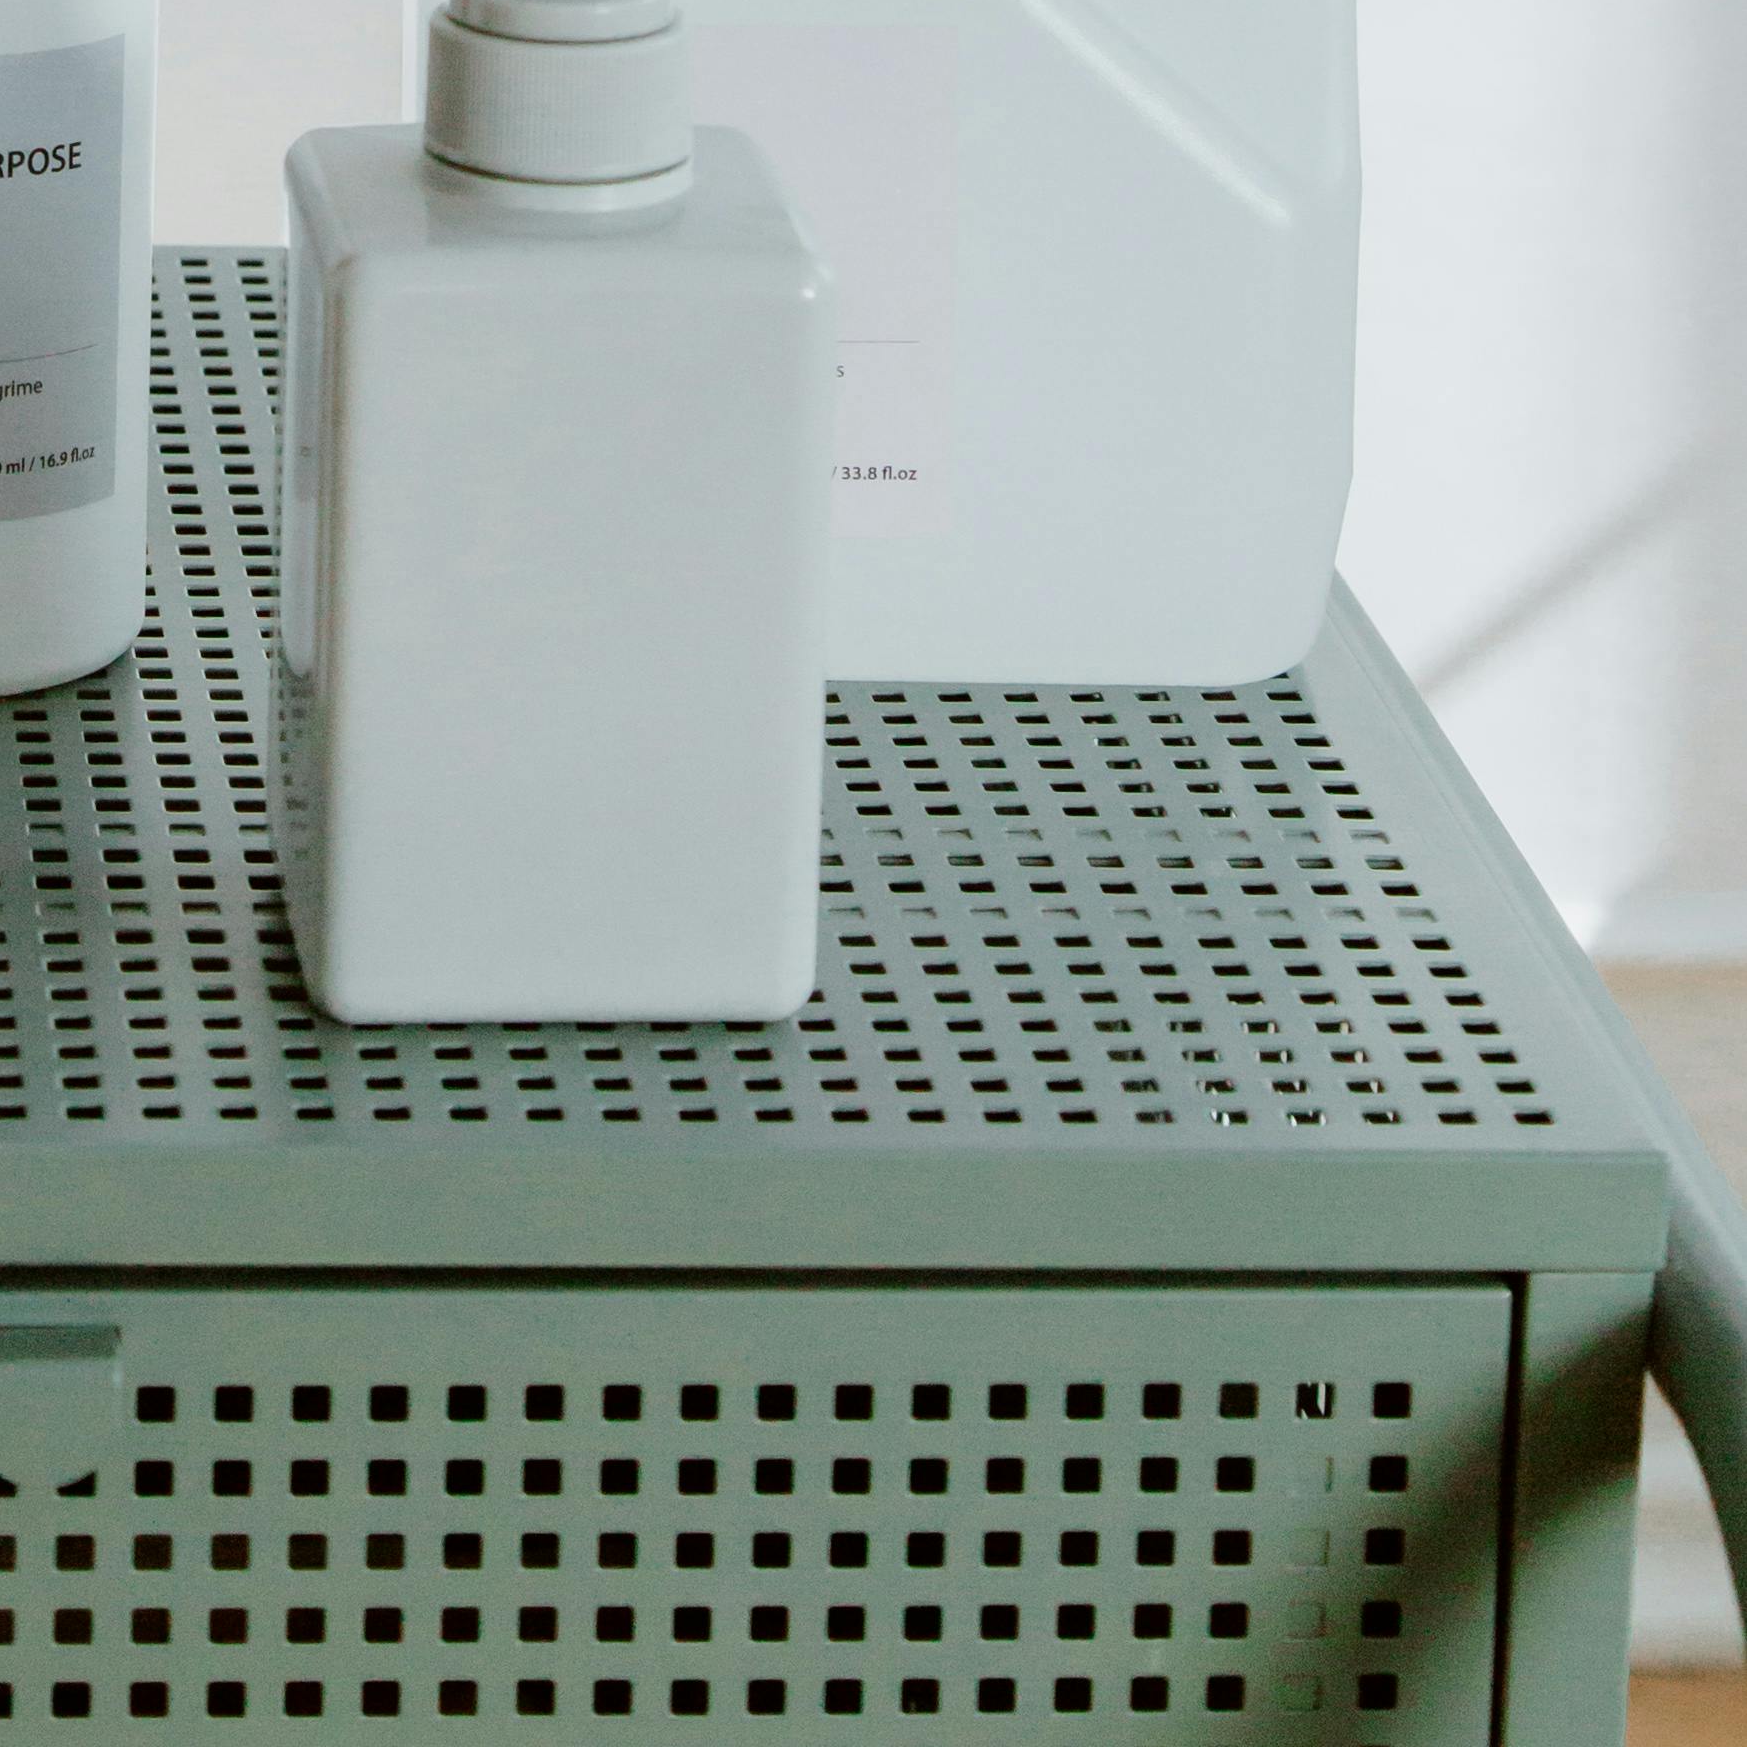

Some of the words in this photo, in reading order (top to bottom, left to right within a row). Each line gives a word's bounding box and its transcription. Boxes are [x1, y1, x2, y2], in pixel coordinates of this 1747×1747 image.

[6, 457, 25, 474] ml
[29, 457, 35, 471] /
[40, 452, 68, 469] 16.9
[70, 447, 95, 463] fl.oz
[841, 466, 877, 480] 33.8
[882, 465, 918, 480] fl.oz
